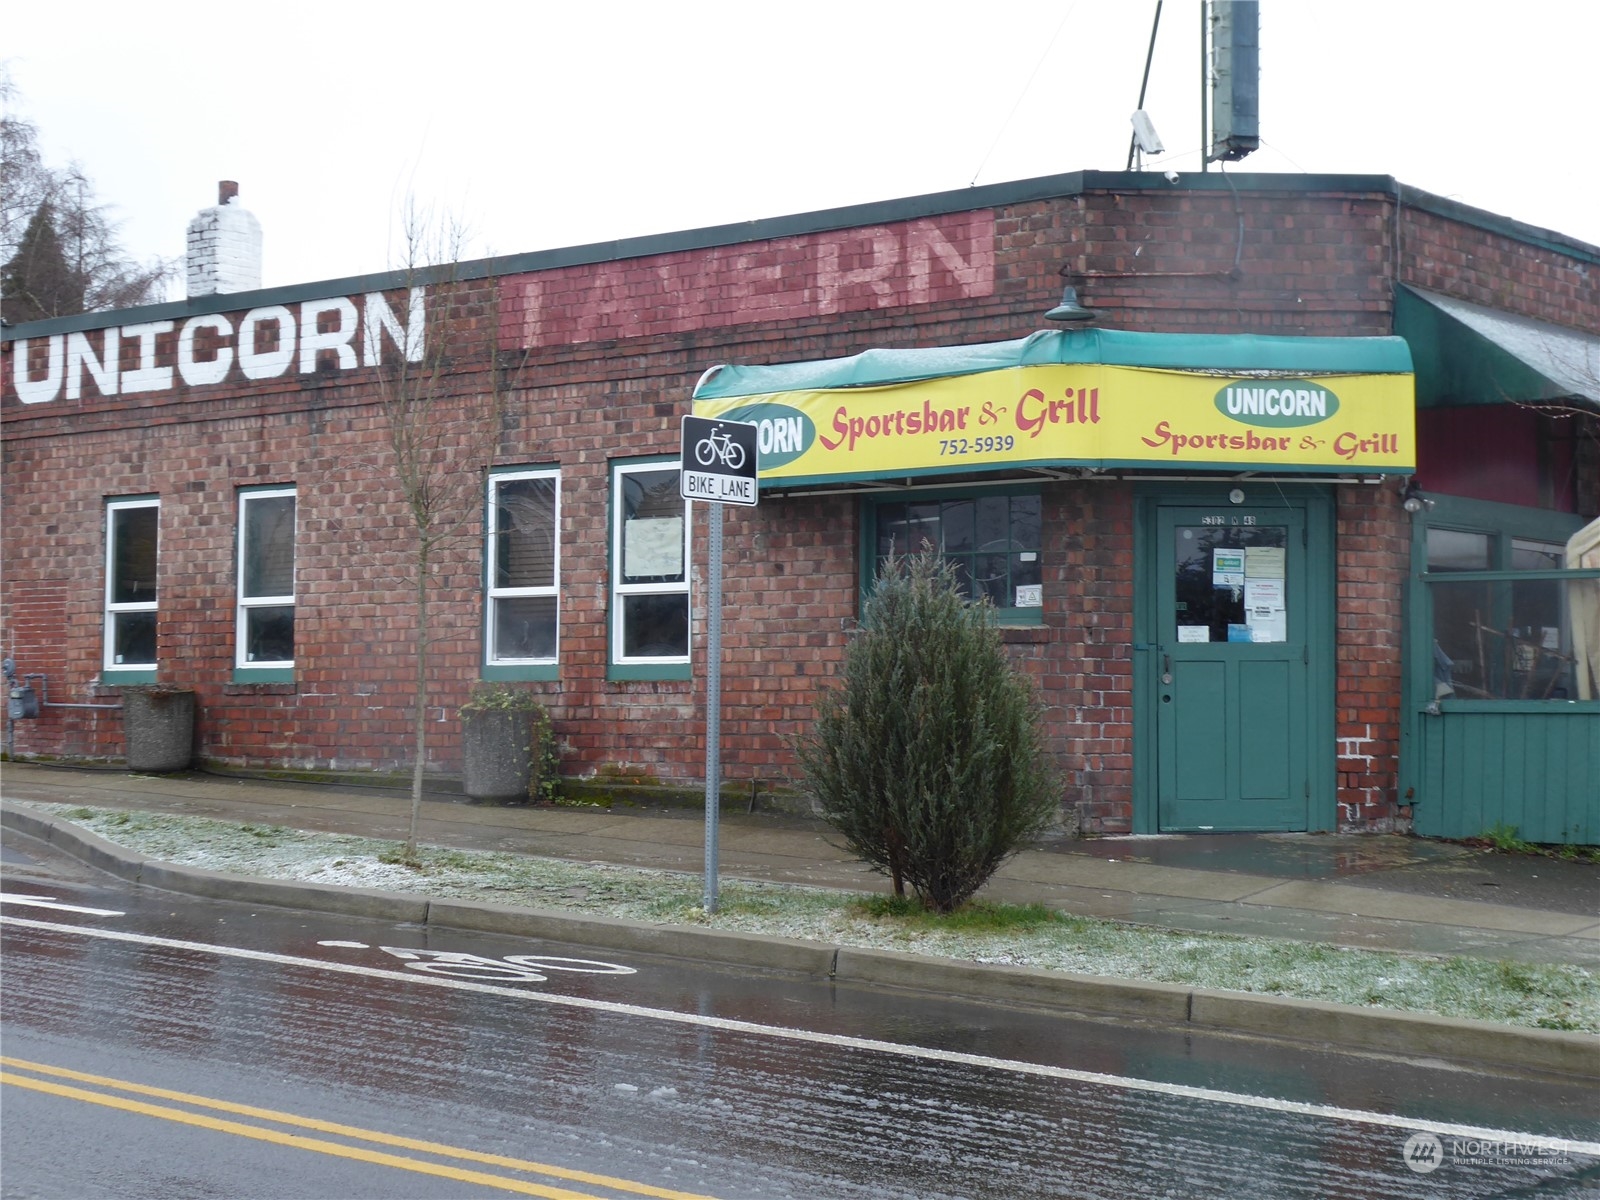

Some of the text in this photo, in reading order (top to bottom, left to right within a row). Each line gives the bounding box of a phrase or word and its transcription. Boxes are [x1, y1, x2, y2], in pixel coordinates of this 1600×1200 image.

[13, 287, 427, 405] UNICORN
[819, 387, 1101, 452] Sportsbar & Grill
[1226, 387, 1327, 417] UNICORN
[939, 435, 1015, 456] 752-5939
[1141, 420, 1399, 460] Sportsbar & Grill
[688, 475, 750, 498] BIKE LANE
